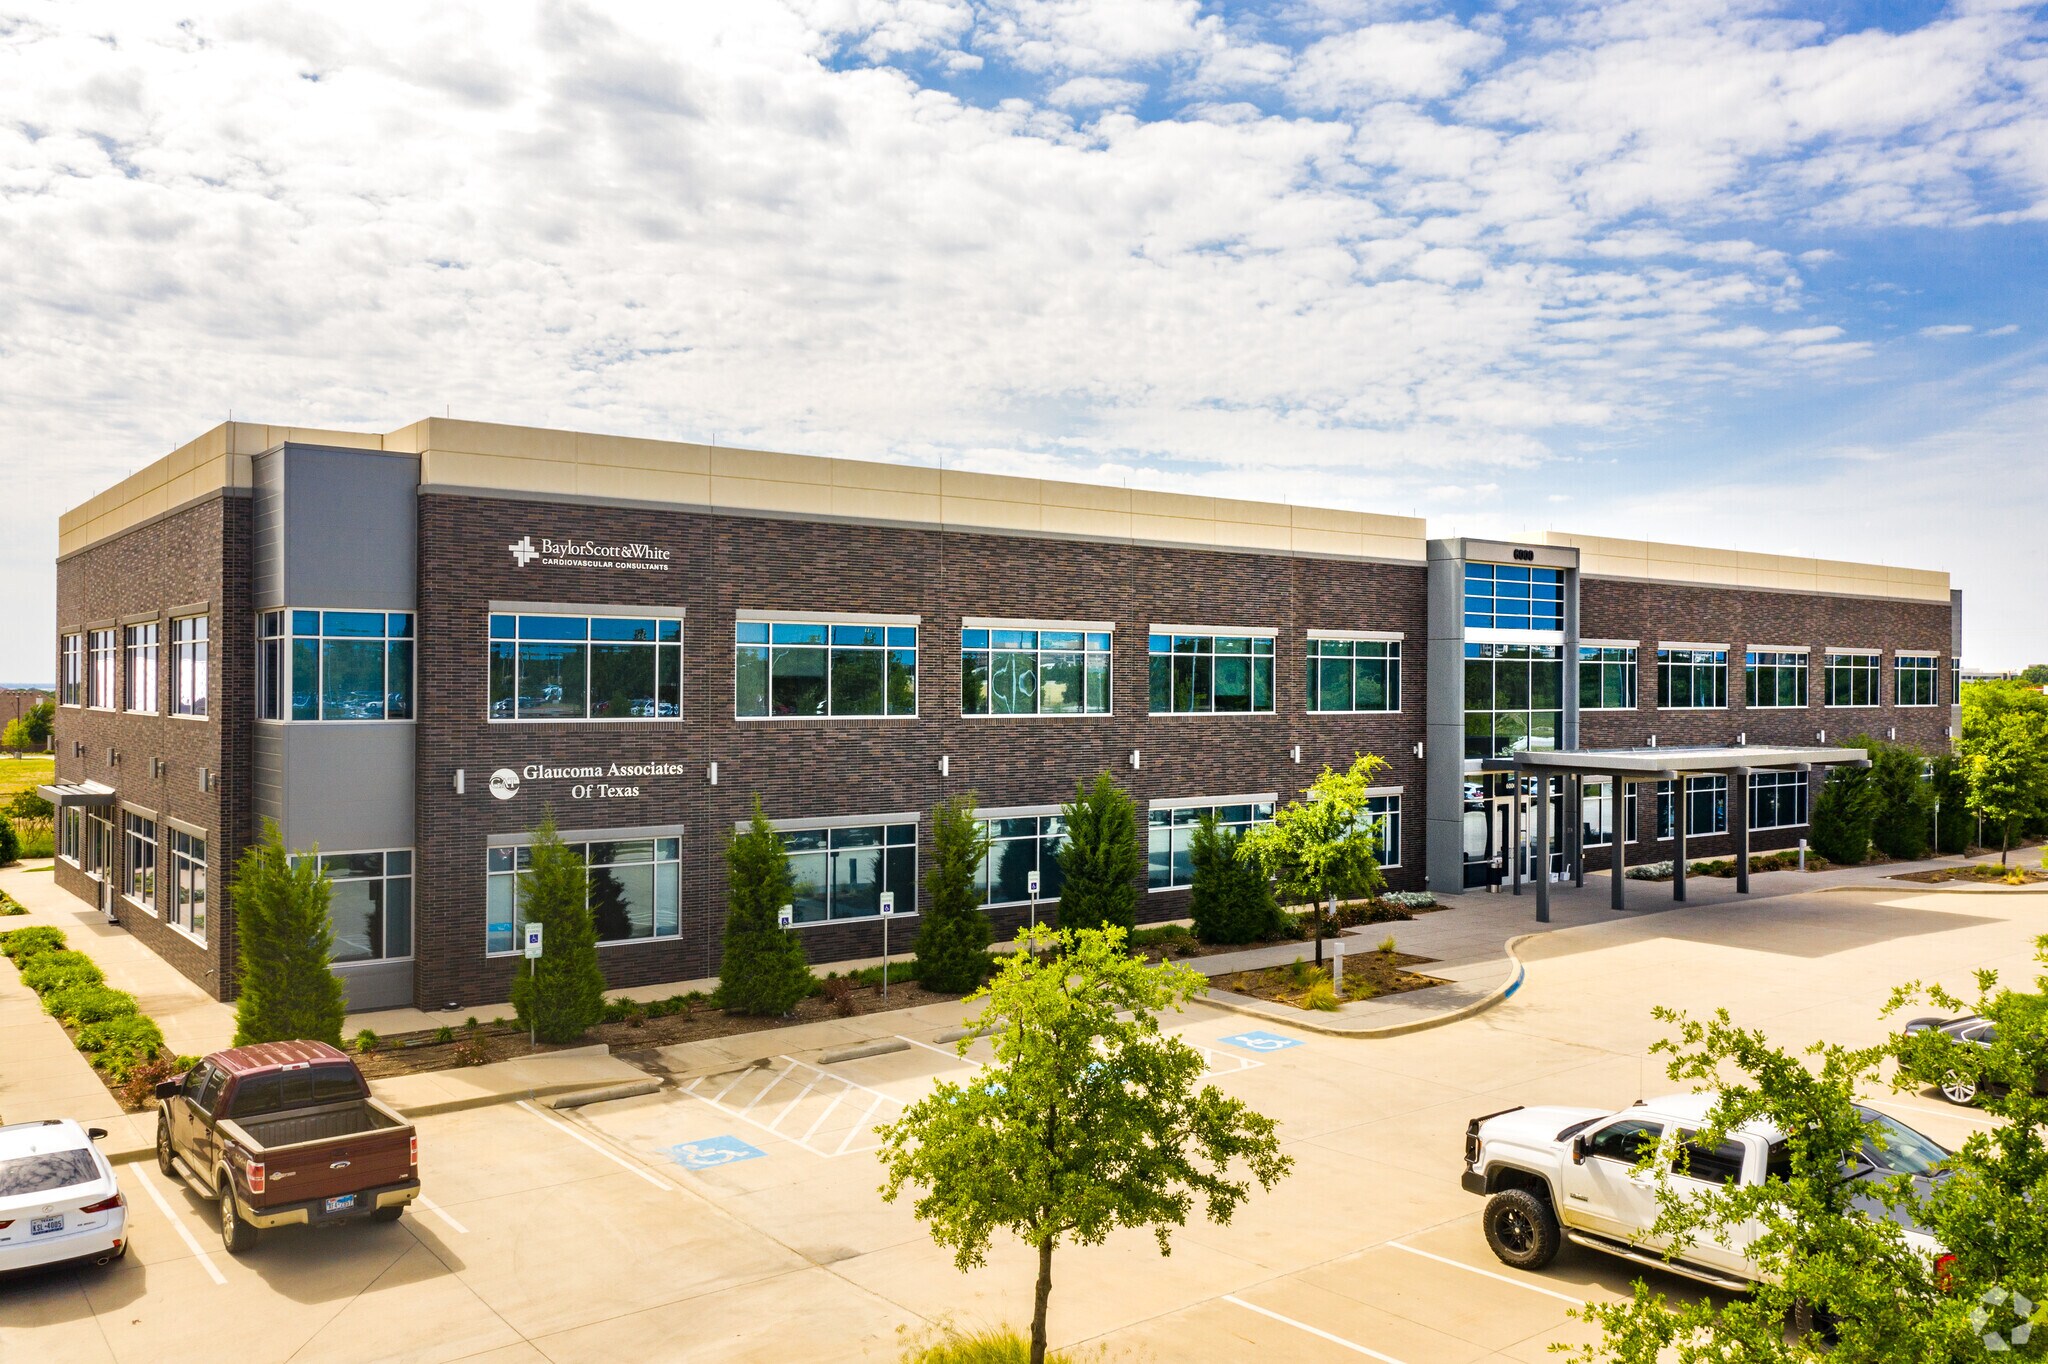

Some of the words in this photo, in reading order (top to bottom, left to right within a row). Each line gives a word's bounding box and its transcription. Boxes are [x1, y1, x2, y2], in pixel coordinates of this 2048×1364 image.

[542, 557, 613, 569] CARDIOVASCULAR
[615, 561, 669, 571] CONSULTANTS
[523, 764, 603, 780] Glaucoma
[607, 761, 684, 777] Associates
[571, 784, 594, 799] Of
[597, 784, 640, 798] Texas
